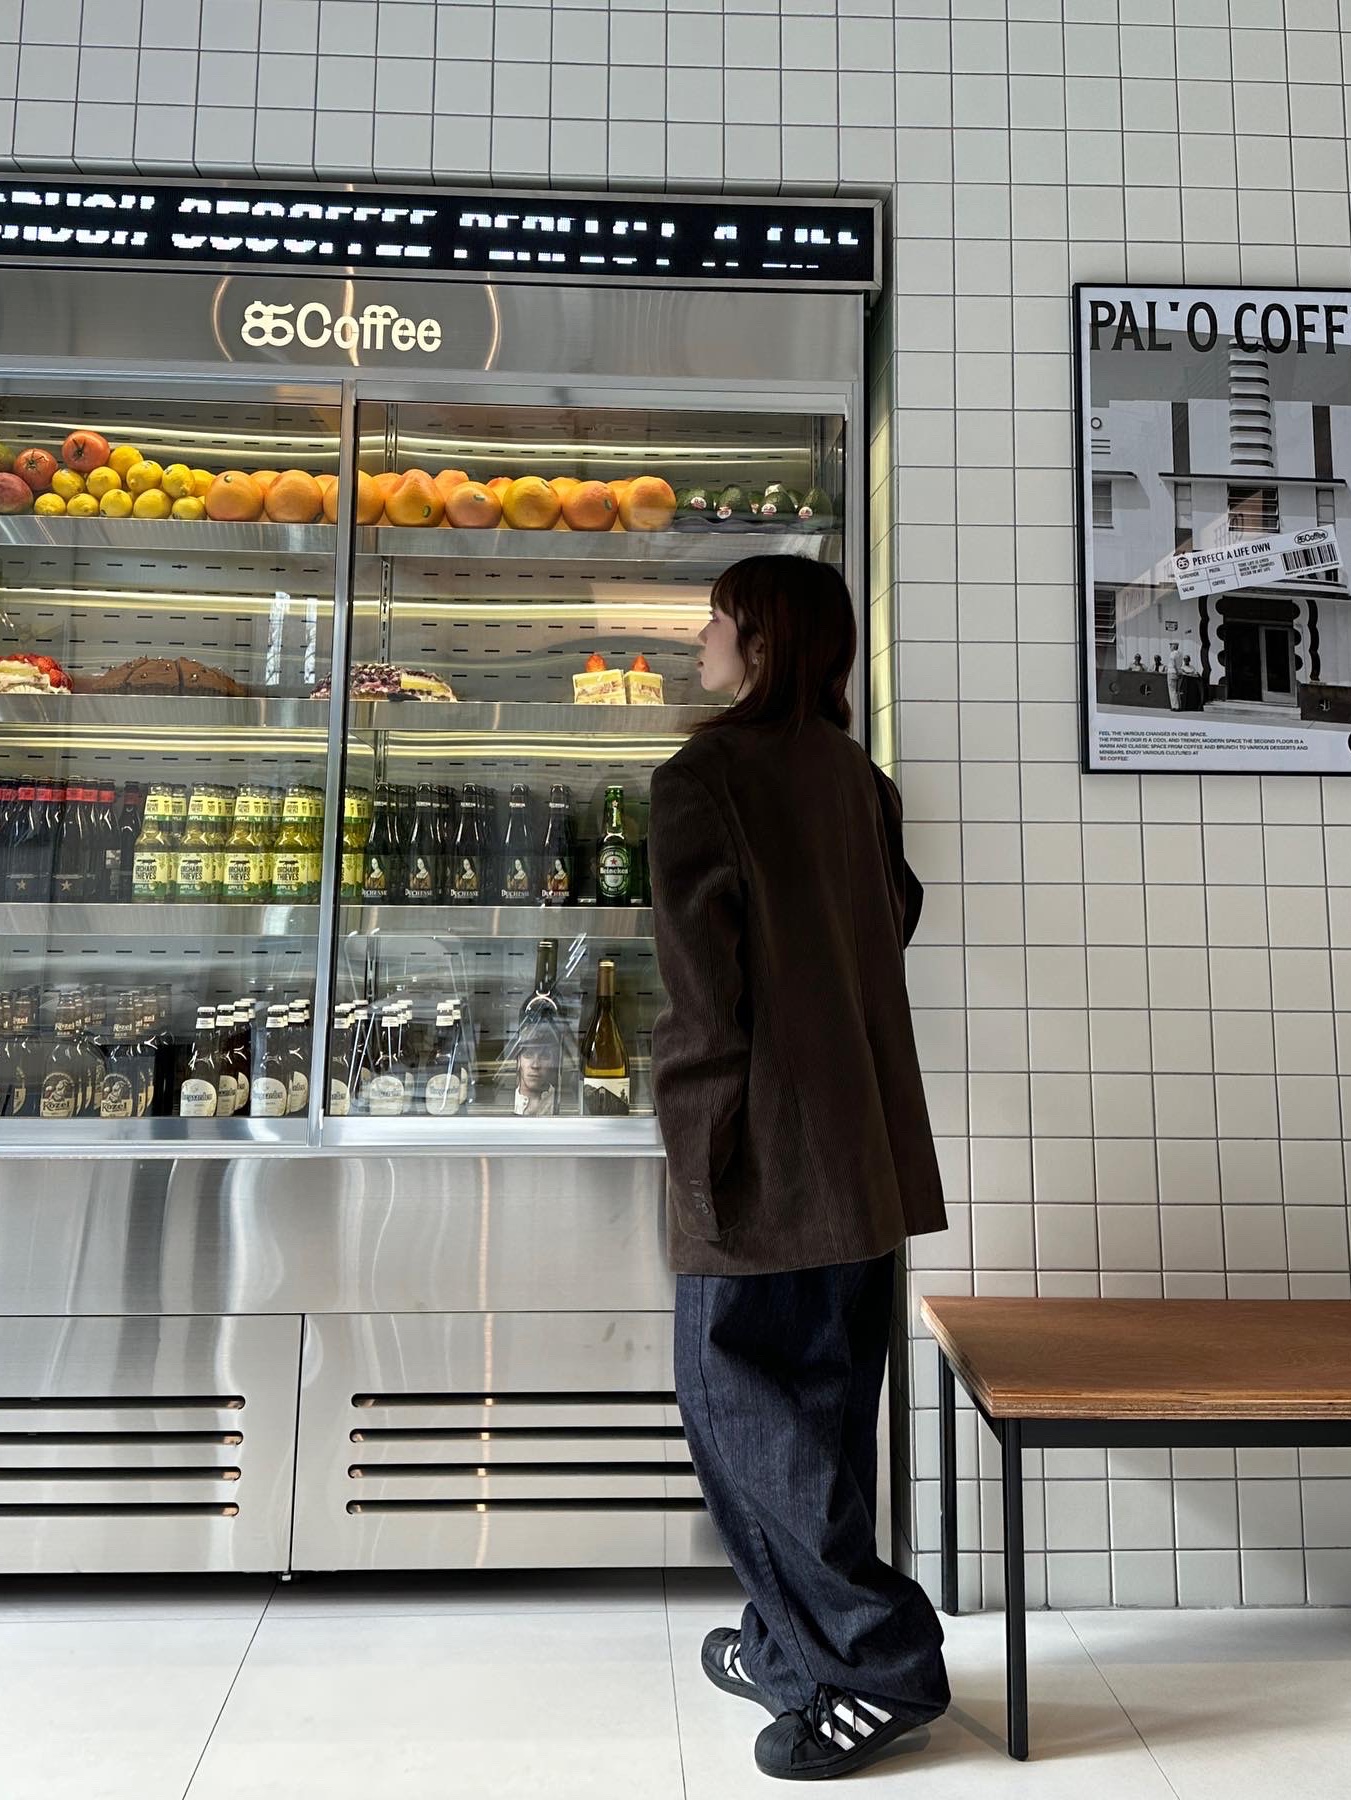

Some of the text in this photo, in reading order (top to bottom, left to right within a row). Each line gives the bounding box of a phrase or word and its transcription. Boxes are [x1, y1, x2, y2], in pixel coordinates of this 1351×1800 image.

[241, 300, 442, 352] 85Coffee
[1233, 302, 1348, 354] COFF
[1192, 542, 1271, 566] PERFECT A LIFE OWN
[55, 1022, 75, 1031] Kozel
[113, 1023, 132, 1032] Kozel
[43, 1101, 70, 1111] Kozel
[102, 1102, 126, 1112] Kozel
